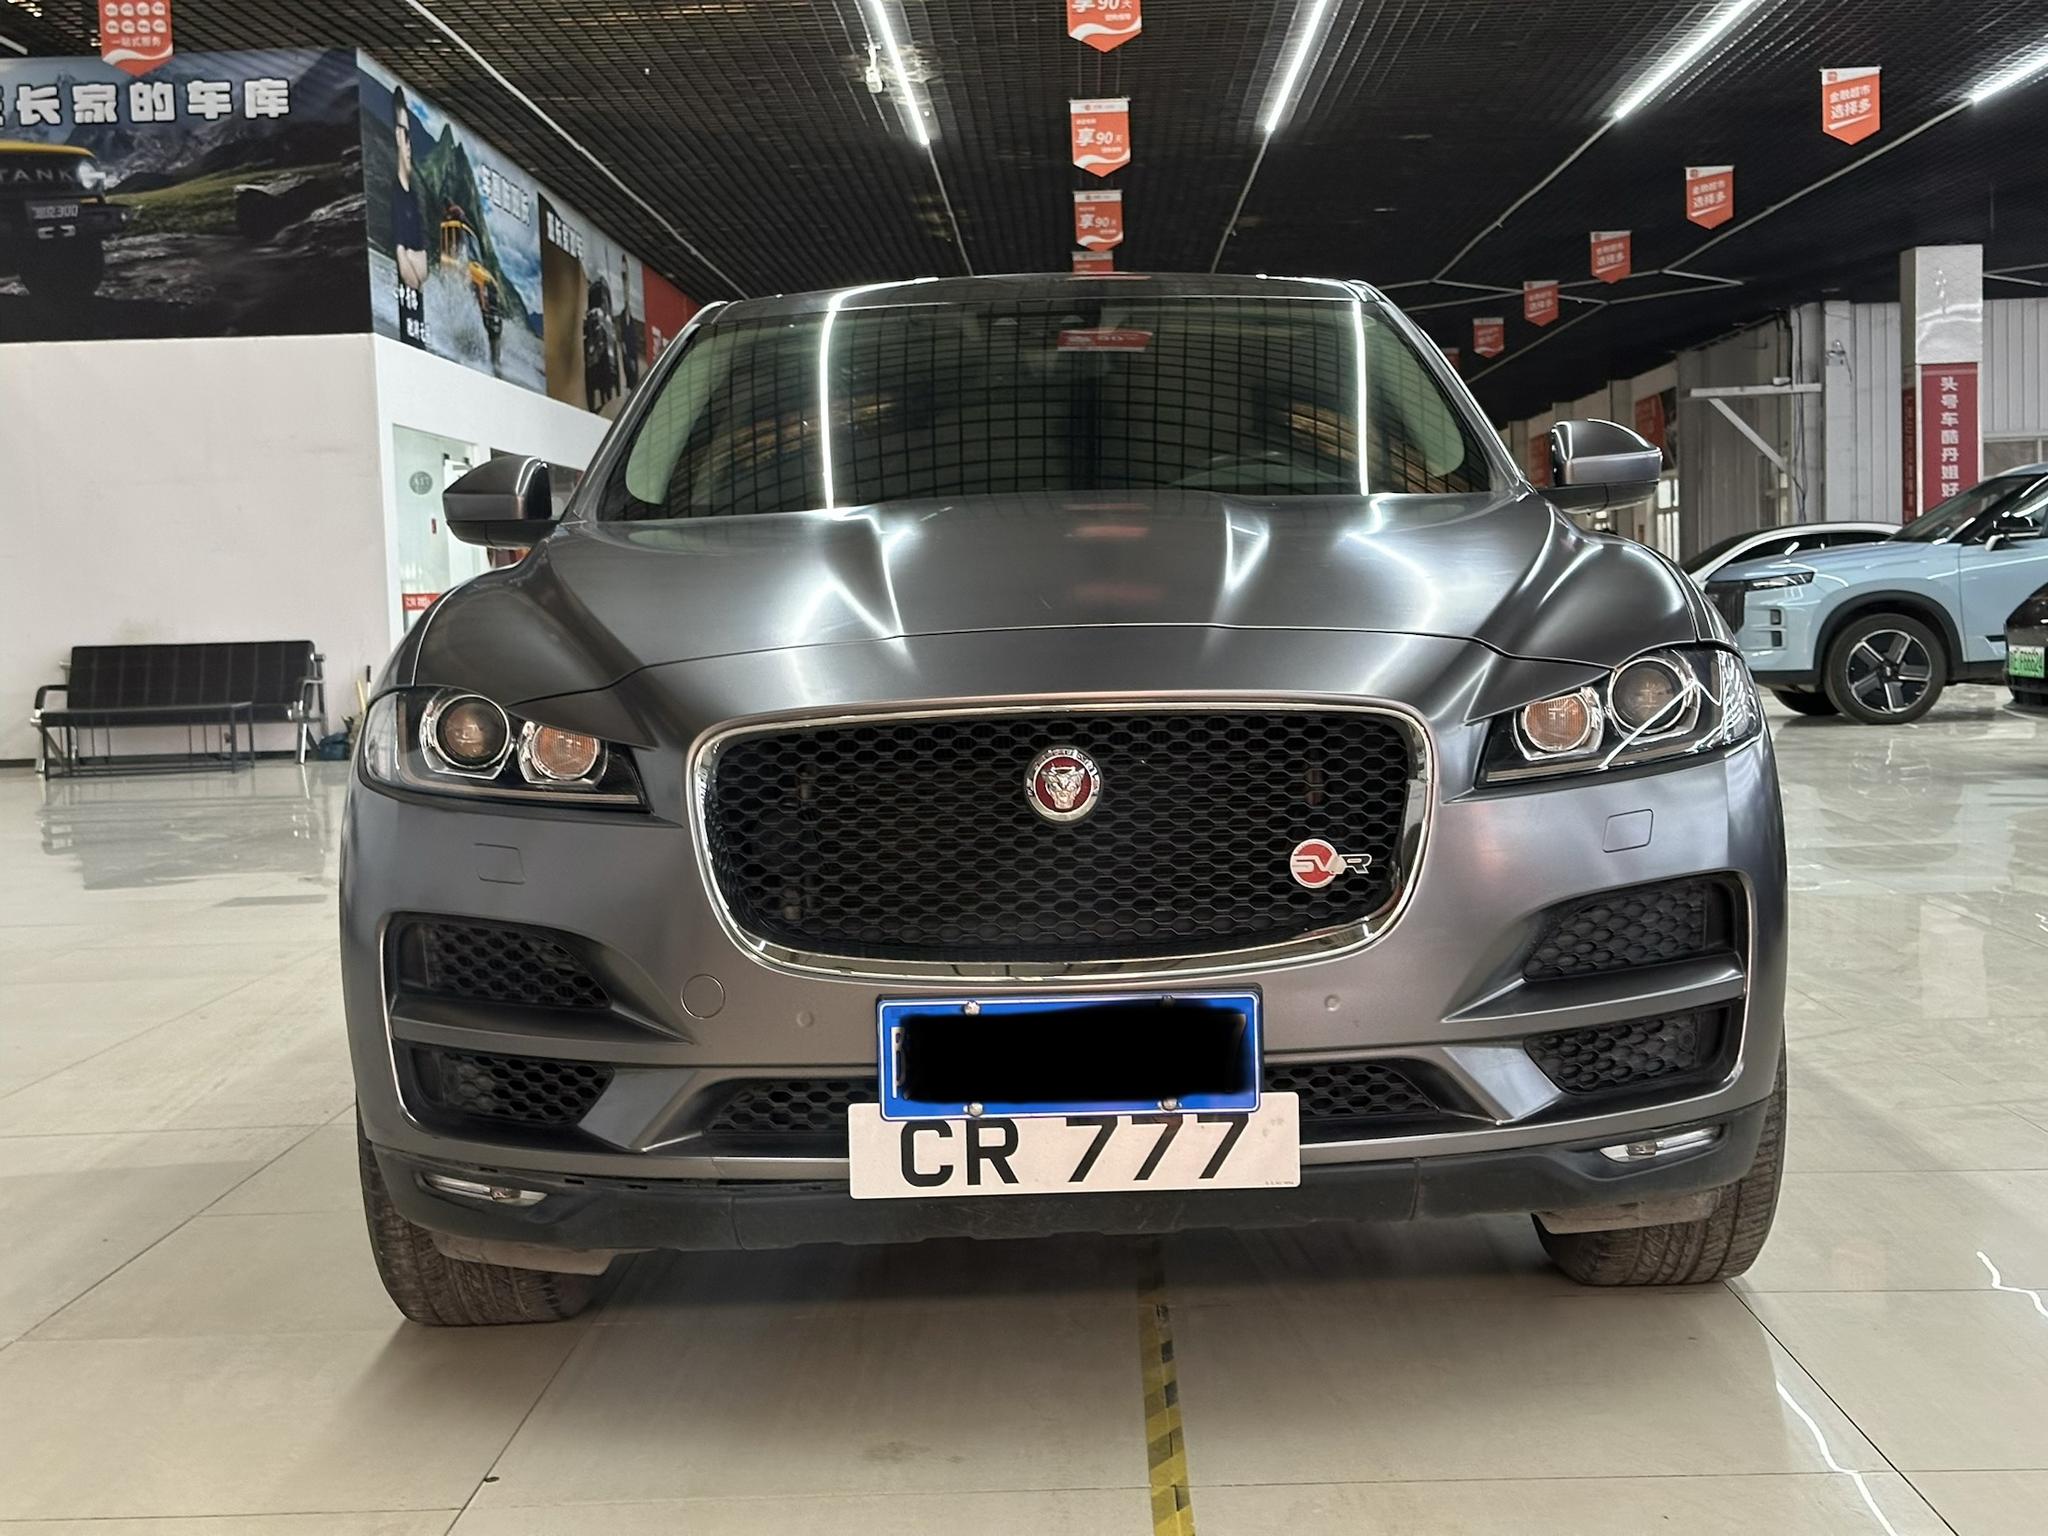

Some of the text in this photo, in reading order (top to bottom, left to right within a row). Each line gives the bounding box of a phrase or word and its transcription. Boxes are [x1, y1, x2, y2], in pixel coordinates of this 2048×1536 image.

[0, 78, 291, 126] 长家的车库
[1831, 98, 1872, 120] 选择多
[900, 1113, 1250, 1188] CR 777
